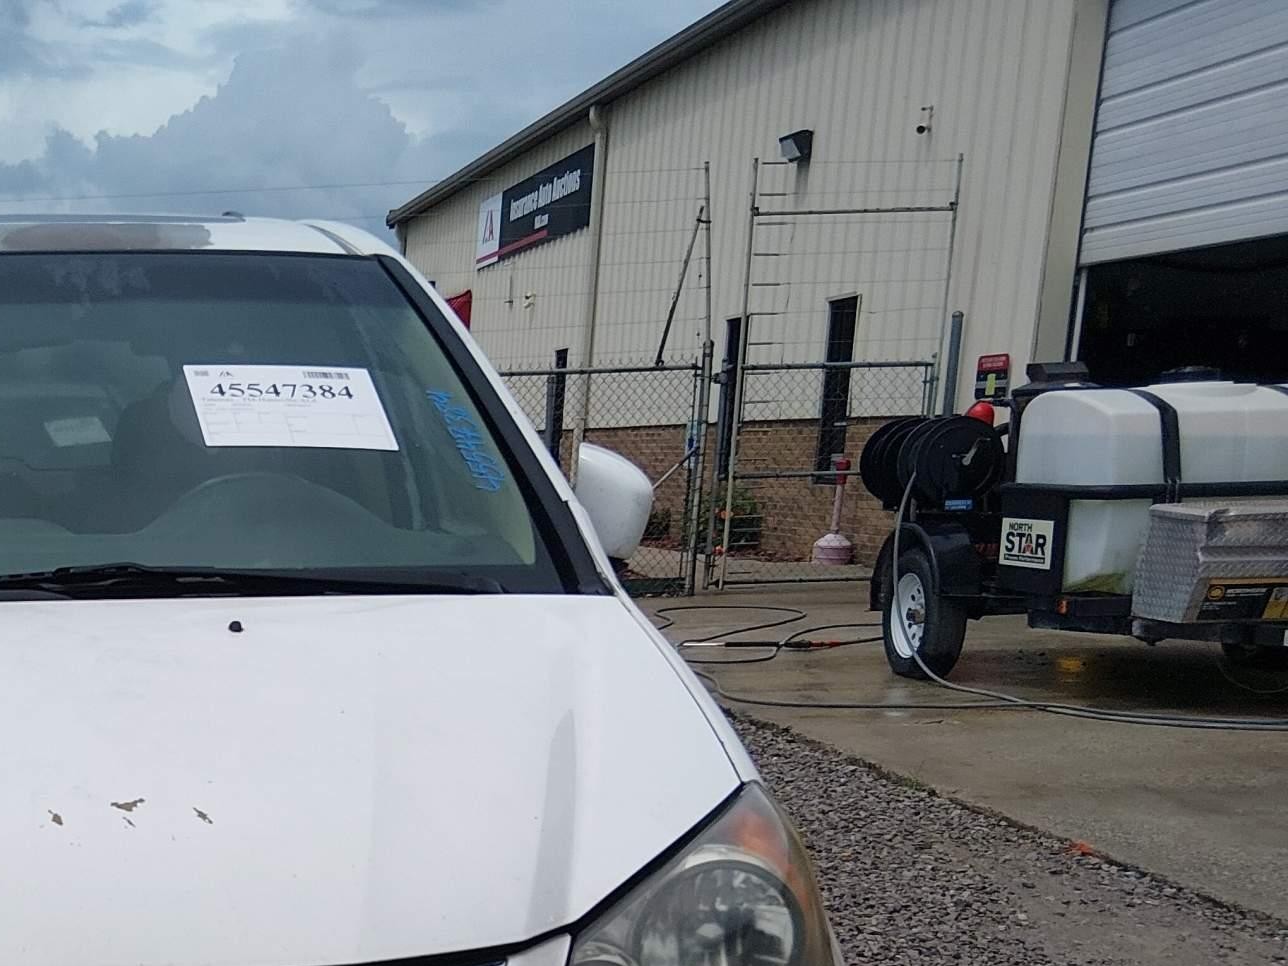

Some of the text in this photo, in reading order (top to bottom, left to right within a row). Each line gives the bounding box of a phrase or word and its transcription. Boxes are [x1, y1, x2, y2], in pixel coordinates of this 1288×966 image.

[509, 190, 538, 222] Insurance
[537, 183, 553, 209] Auto
[551, 169, 581, 202] Auctions
[210, 383, 354, 400] 45547384
[1009, 522, 1033, 532] NORTH
[1005, 531, 1047, 556] STAR
